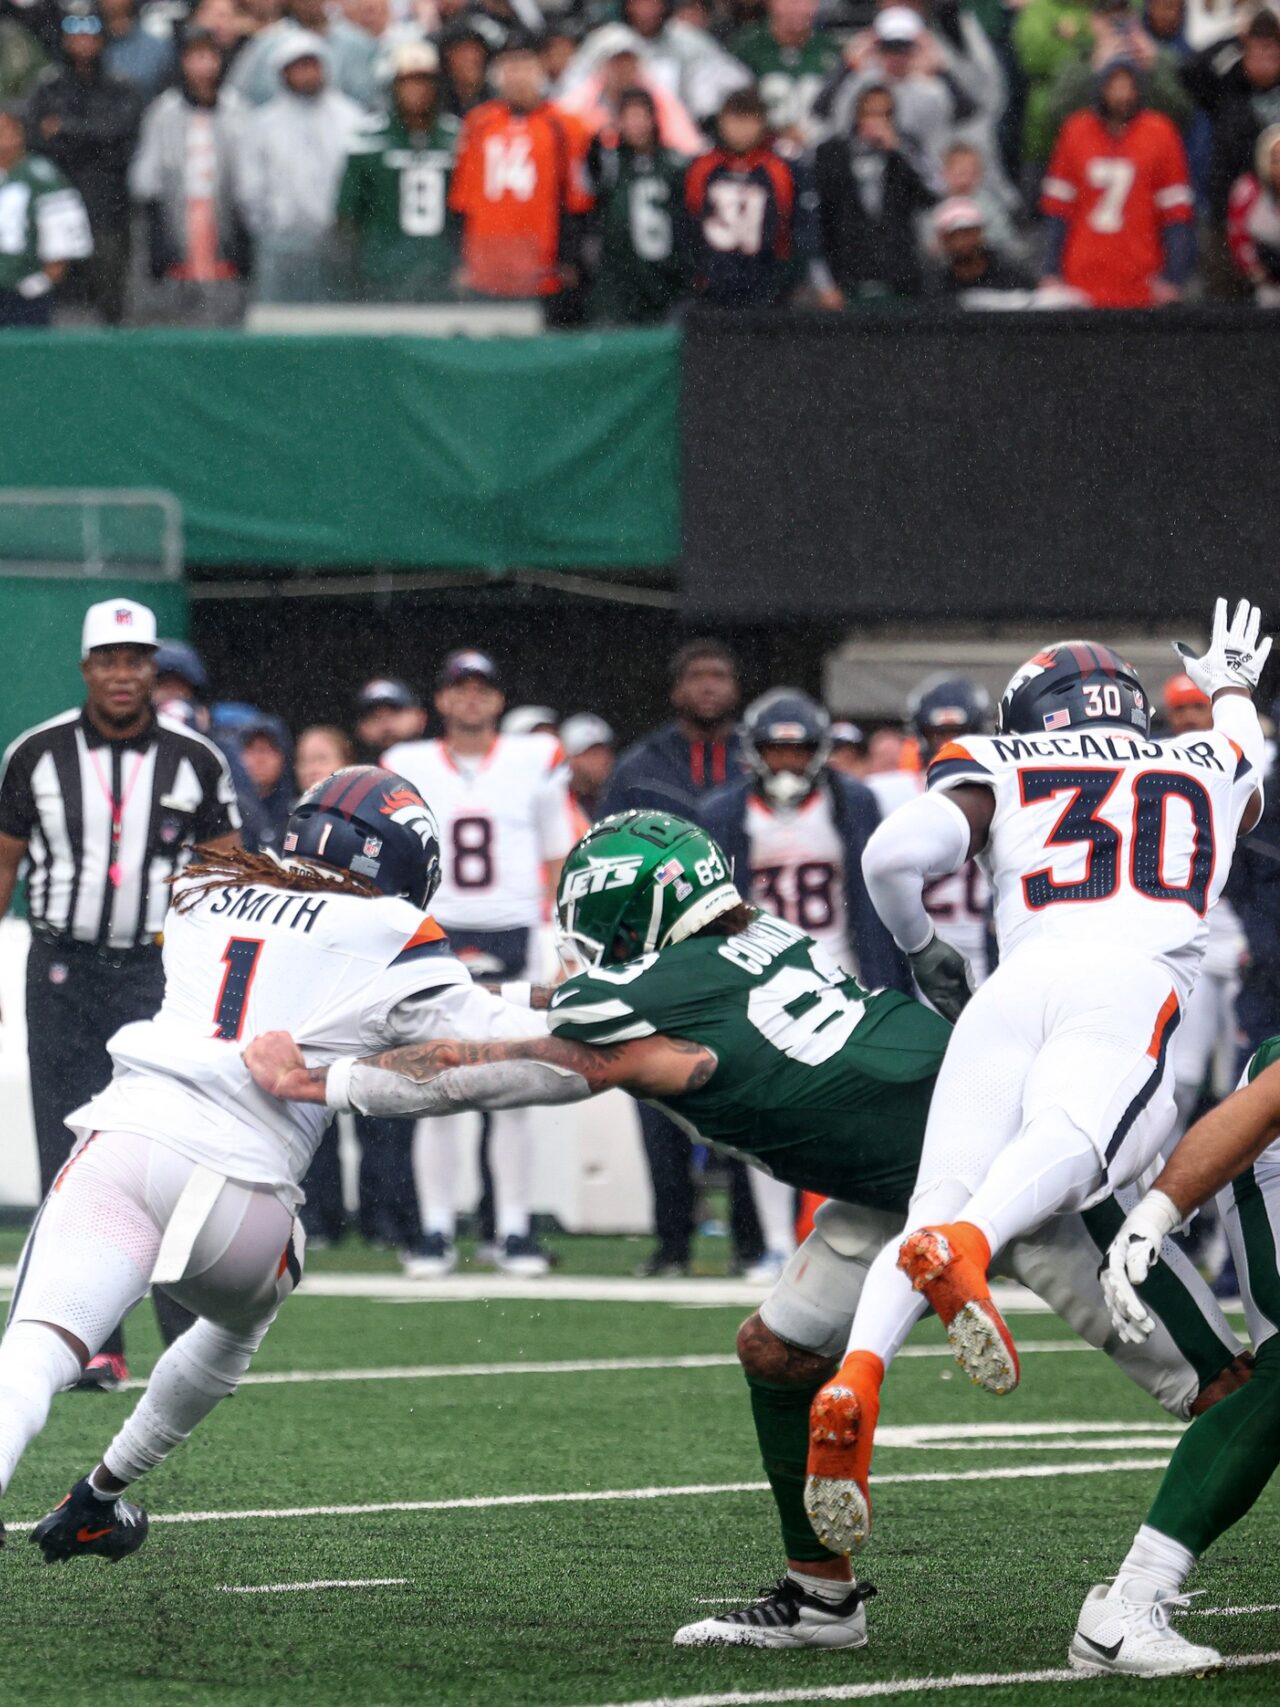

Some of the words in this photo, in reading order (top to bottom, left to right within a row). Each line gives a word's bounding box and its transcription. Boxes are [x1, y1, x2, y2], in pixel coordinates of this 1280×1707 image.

[484, 133, 537, 202] 14
[1087, 157, 1135, 233] 7
[629, 177, 672, 260] 6
[1082, 685, 1122, 717] 30
[317, 822, 333, 855] 1
[451, 813, 494, 890] 8
[694, 857, 726, 887] 83
[1017, 767, 1217, 919] 30
[210, 885, 328, 934] SMITH
[559, 856, 644, 906] JETS
[212, 936, 265, 1042] 1
